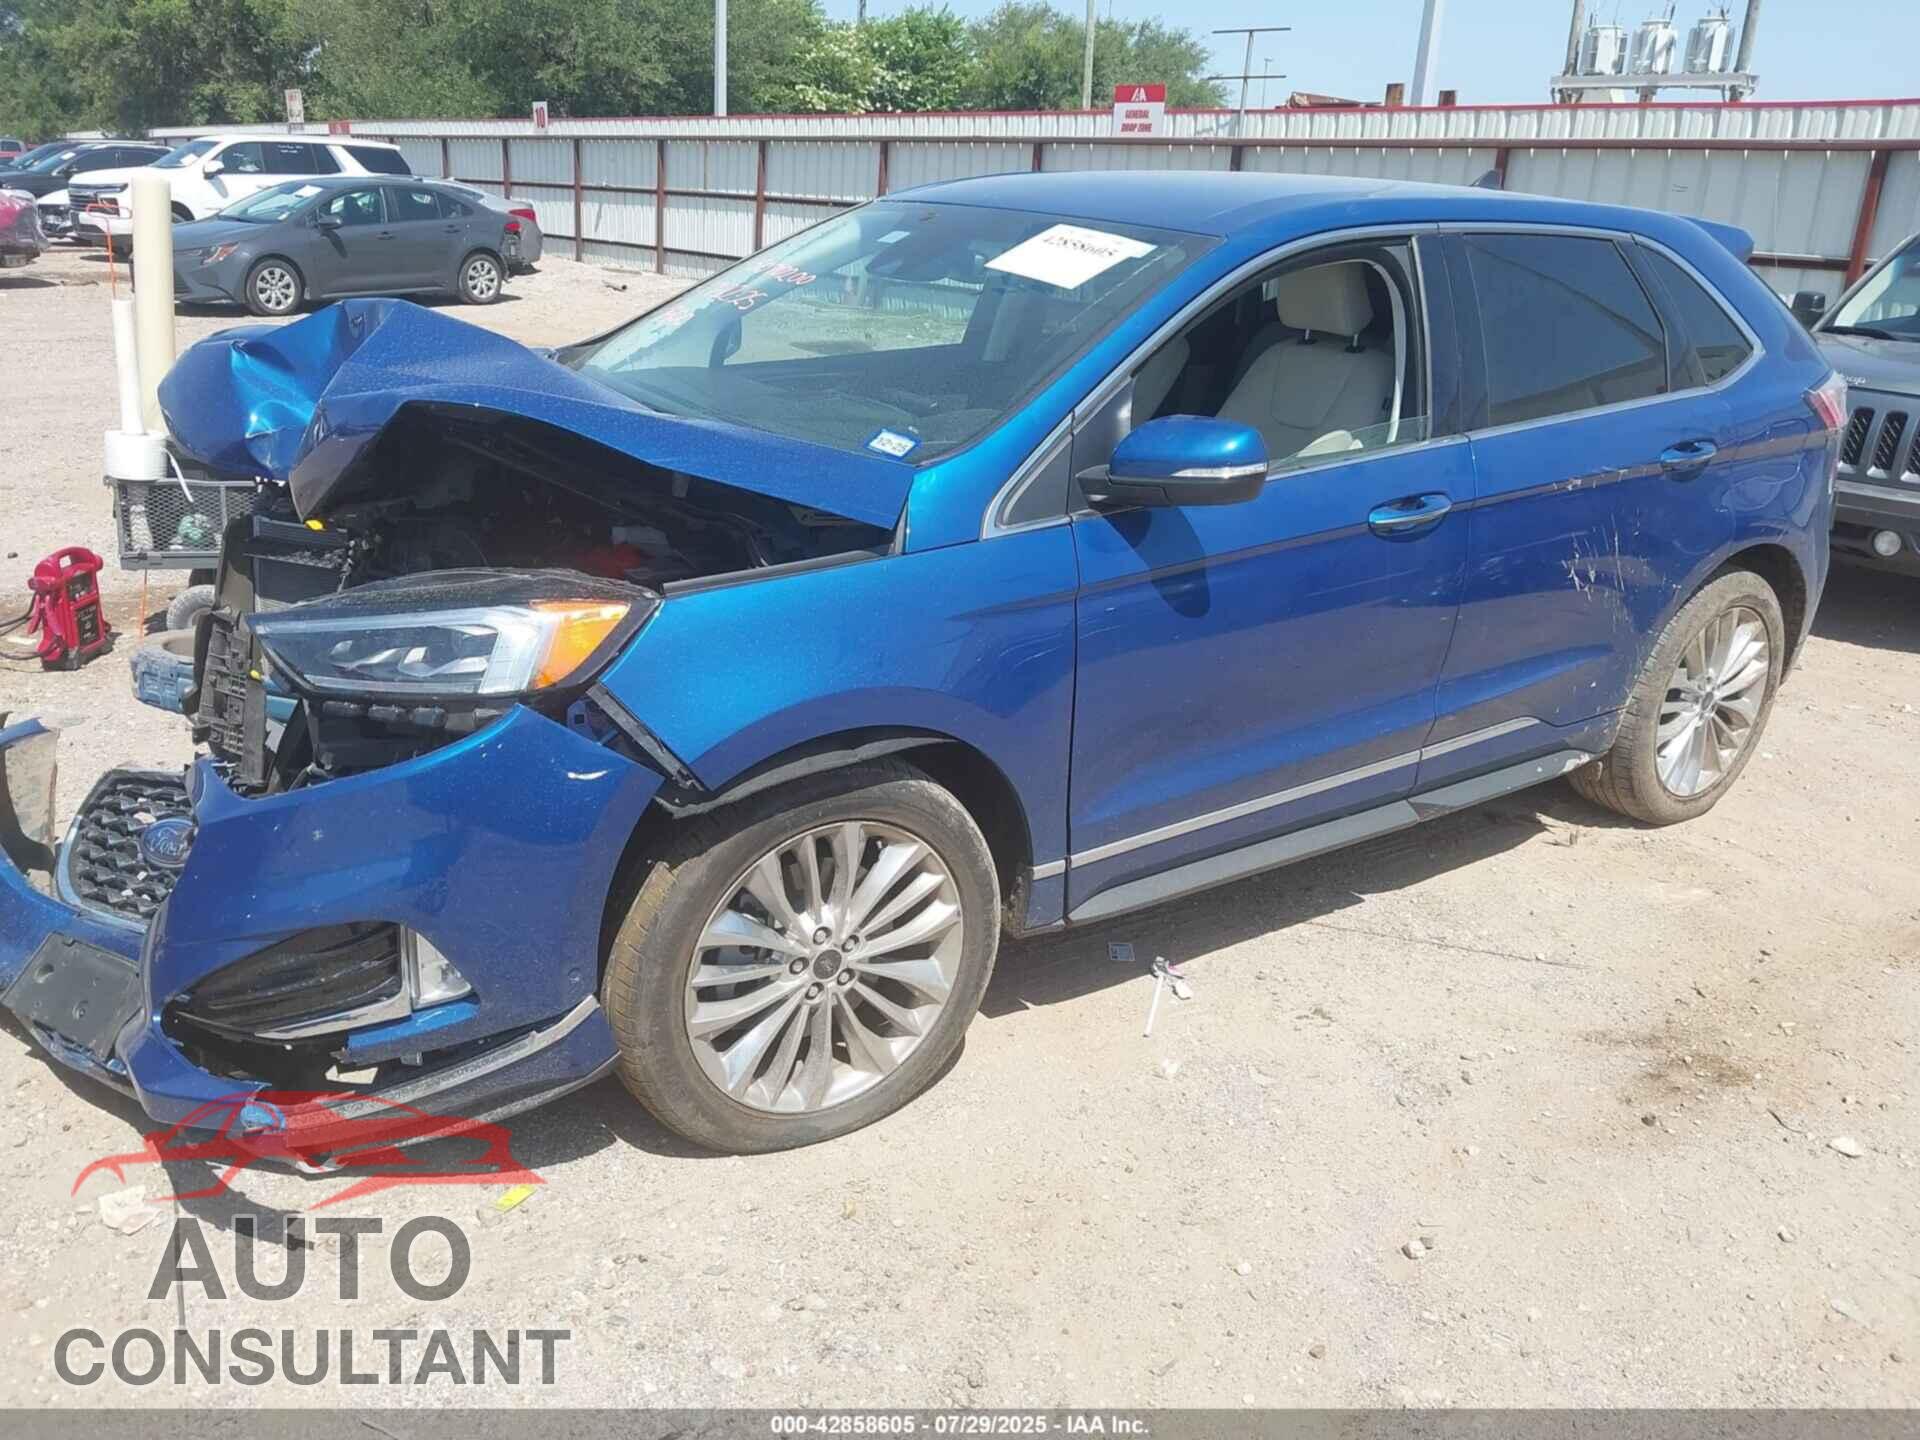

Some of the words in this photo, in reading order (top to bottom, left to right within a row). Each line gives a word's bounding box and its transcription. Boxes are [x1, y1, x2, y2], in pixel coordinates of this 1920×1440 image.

[535, 106, 545, 128] 10
[1125, 109, 1150, 119] GENERAL
[1120, 123, 1137, 132] DROP
[1137, 123, 1152, 132] ZONE
